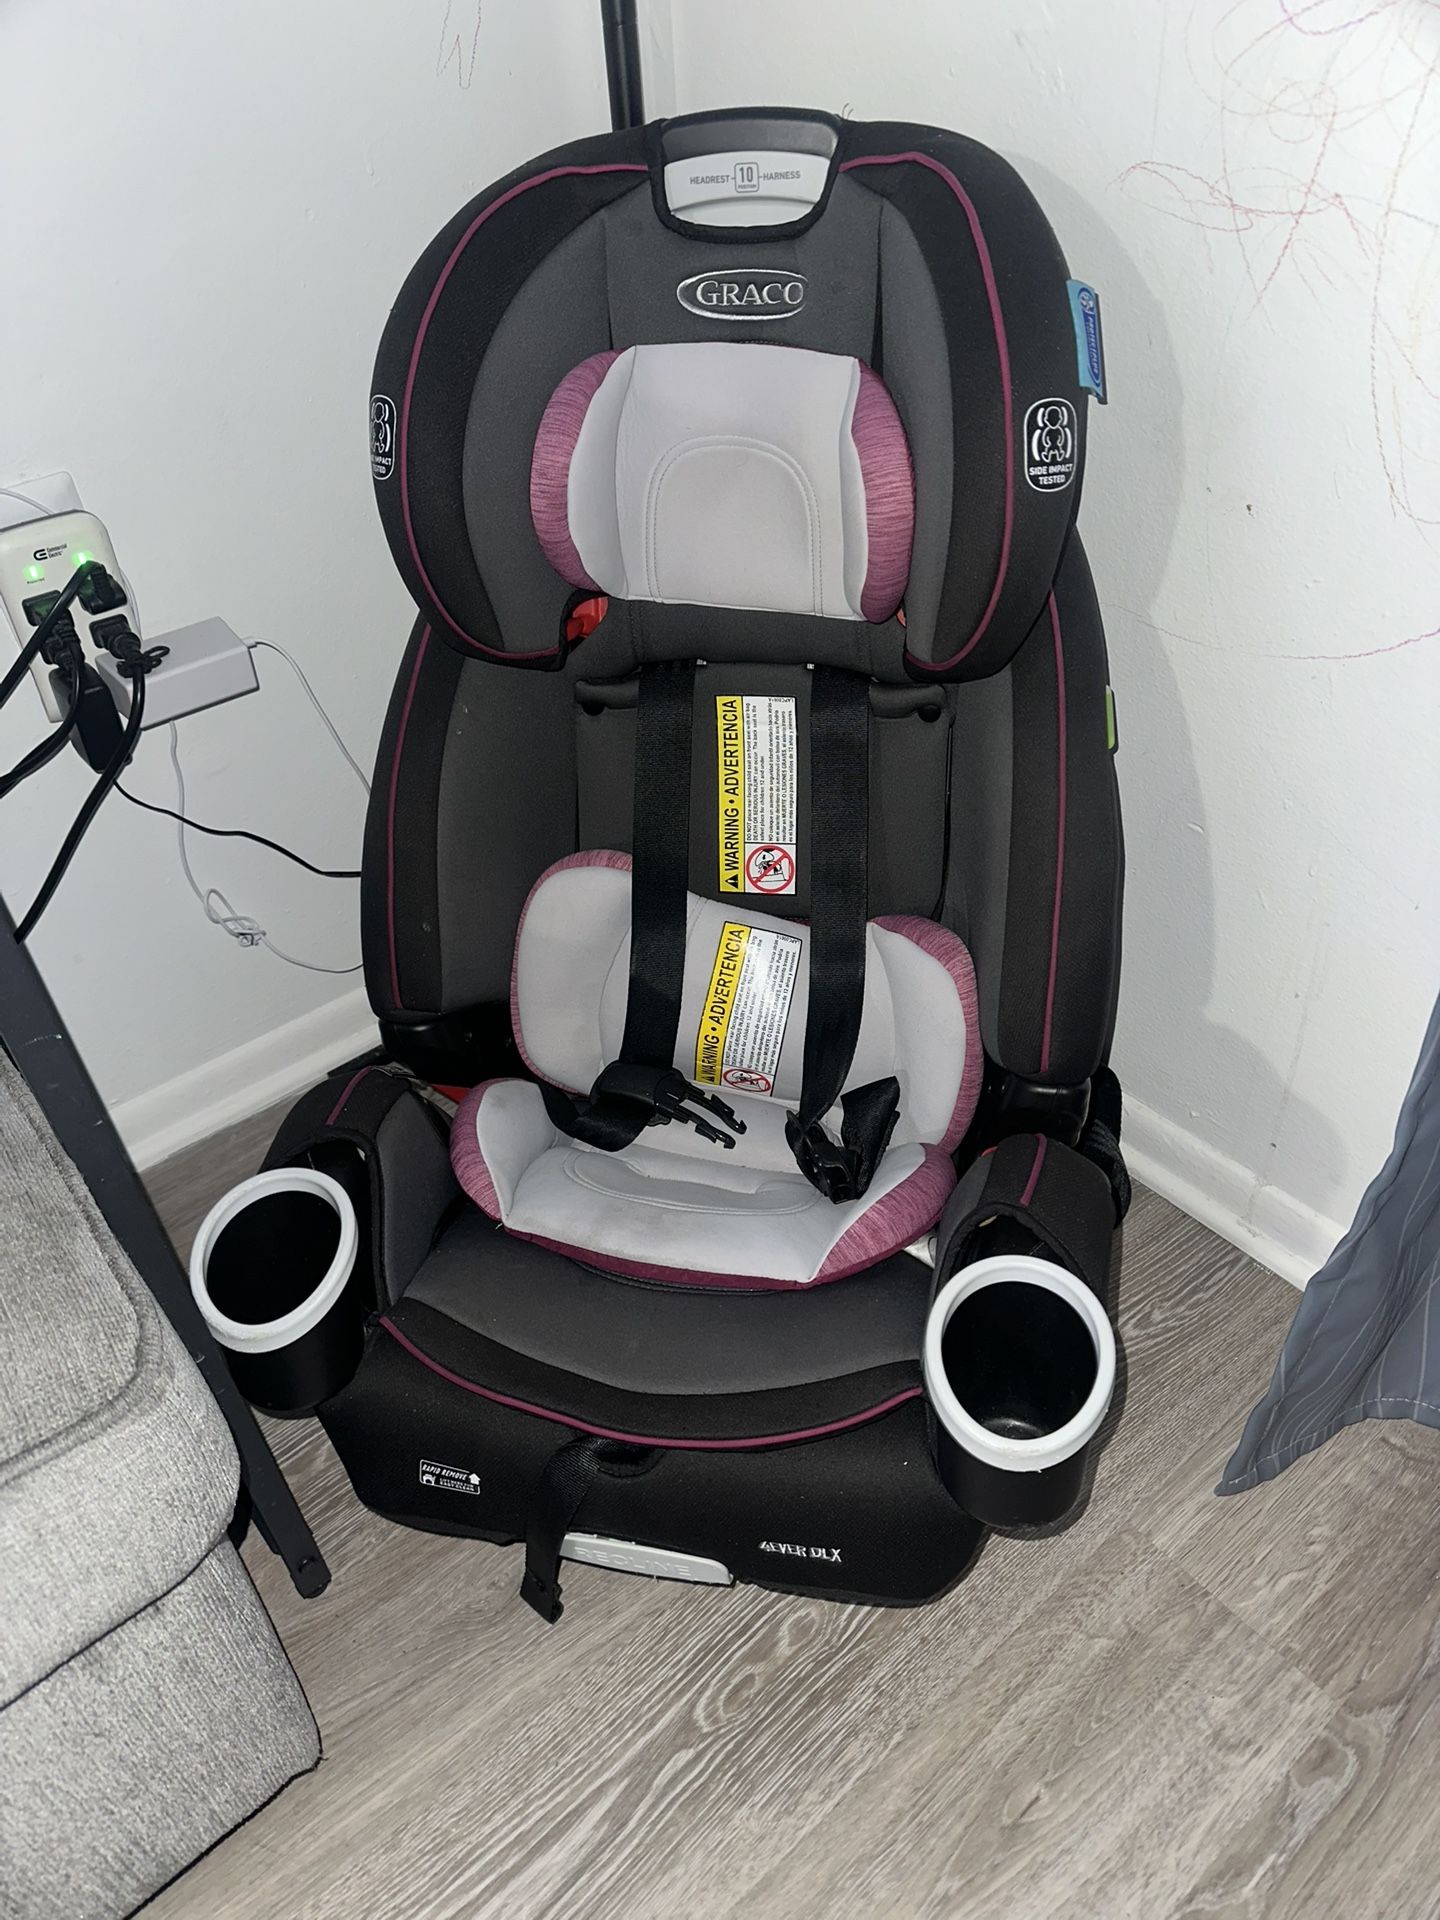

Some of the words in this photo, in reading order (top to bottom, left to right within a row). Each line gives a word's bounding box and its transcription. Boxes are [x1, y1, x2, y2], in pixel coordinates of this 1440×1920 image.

[690, 174, 730, 184] HEADREST
[739, 166, 753, 183] 10
[762, 171, 801, 181] HARNESS
[696, 280, 804, 306] GRACO
[1029, 466, 1048, 476] SIDE
[1048, 463, 1073, 474] IMPACT
[1038, 474, 1066, 485] TESTED
[722, 700, 739, 796] ADVERTENCIA
[724, 808, 739, 871] WARNING
[709, 929, 745, 1026] ADVERTENCIA
[701, 1034, 720, 1075] WARNING
[422, 1464, 441, 1475] RAPID
[441, 1469, 468, 1481] REMOVE
[759, 1541, 807, 1557] 4EVER
[809, 1546, 842, 1562] DLX
